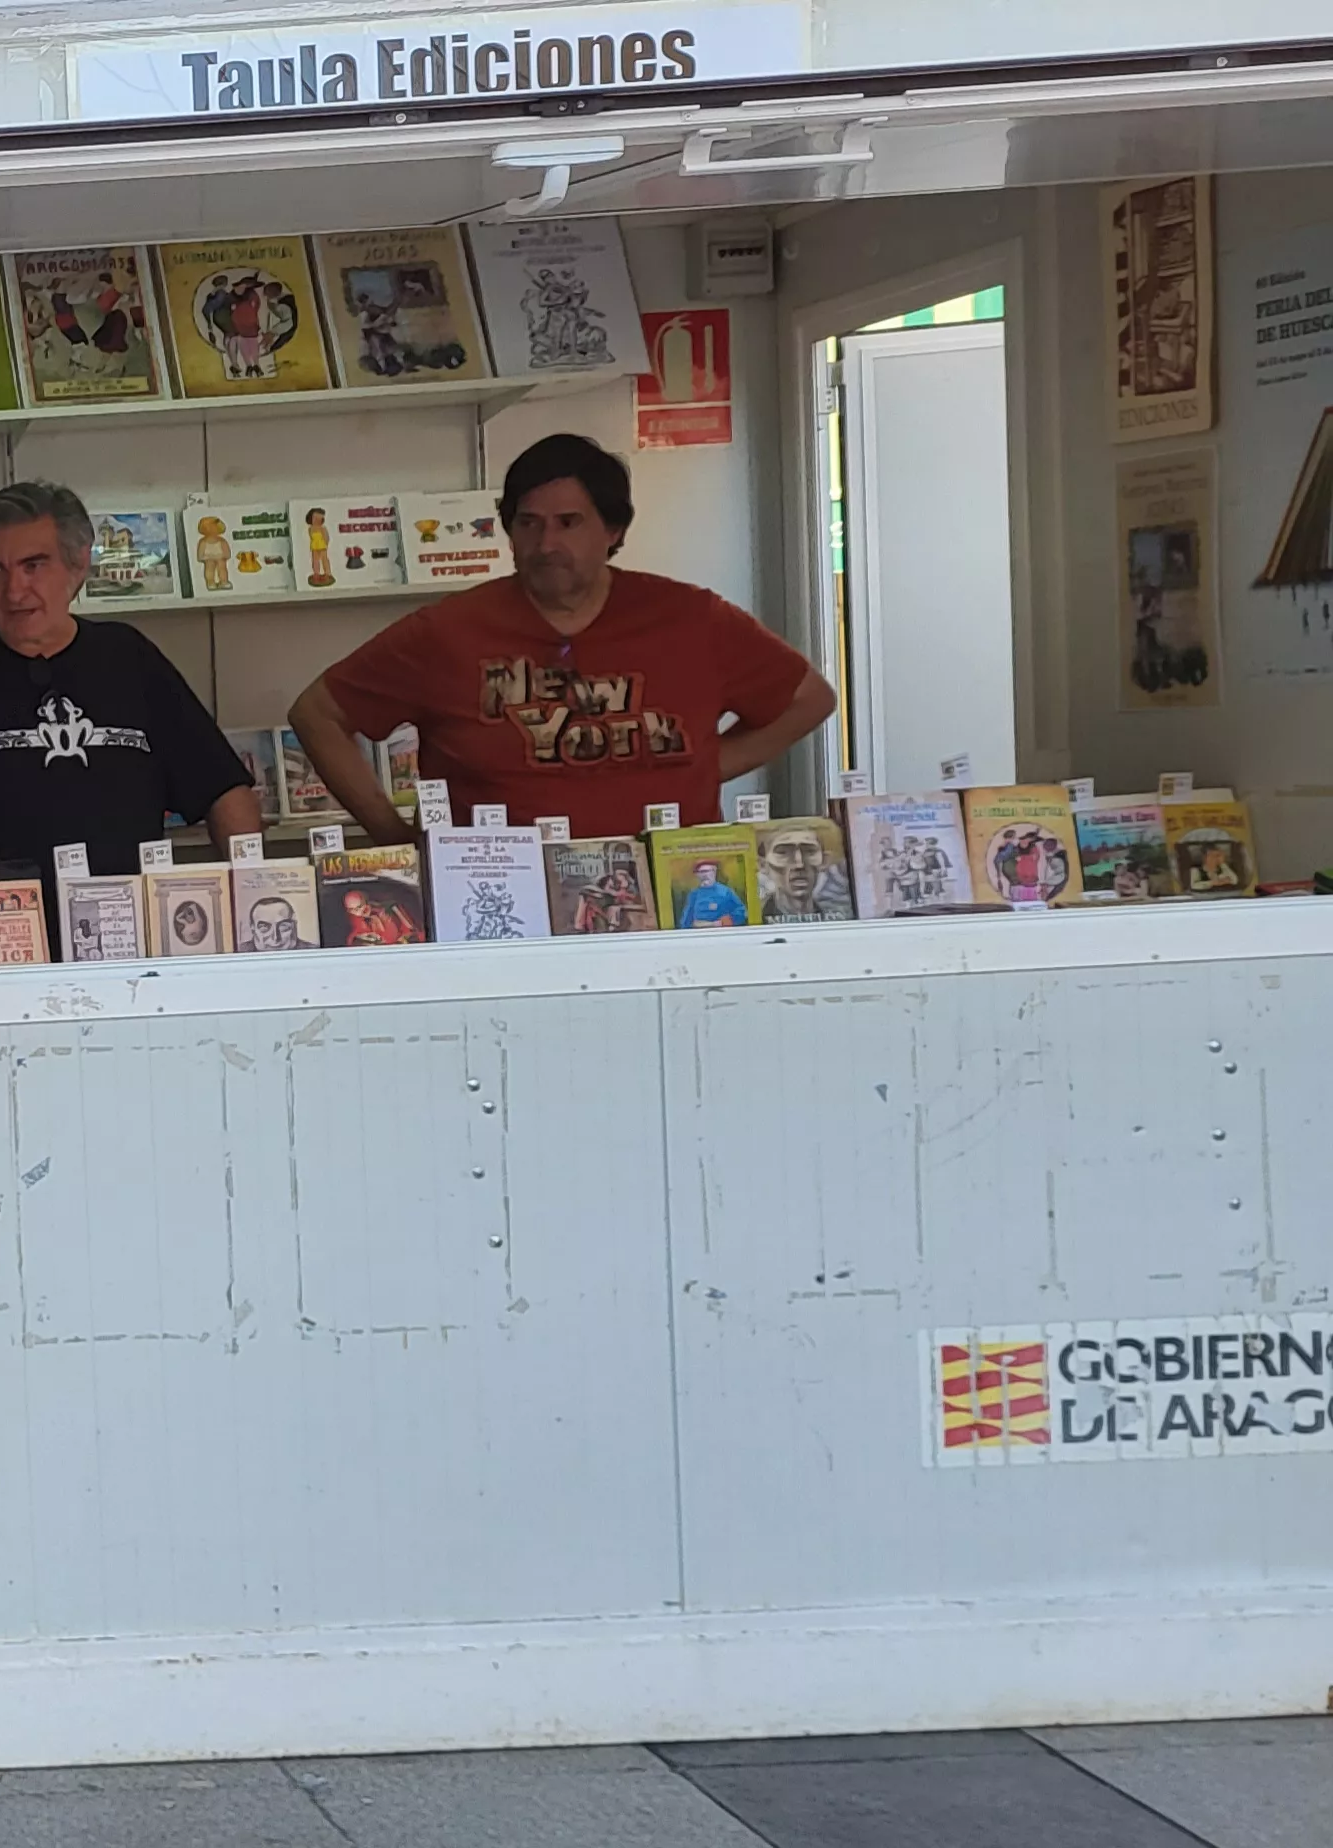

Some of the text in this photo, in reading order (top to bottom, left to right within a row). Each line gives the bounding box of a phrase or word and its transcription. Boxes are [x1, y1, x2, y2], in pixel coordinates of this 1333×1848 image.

[181, 28, 697, 112] Taula Ediciones
[1256, 294, 1302, 319] FERIA
[1256, 326, 1278, 344] DE
[1059, 1330, 1333, 1384] GOBIERN
[1157, 1388, 1333, 1440] ARAG
